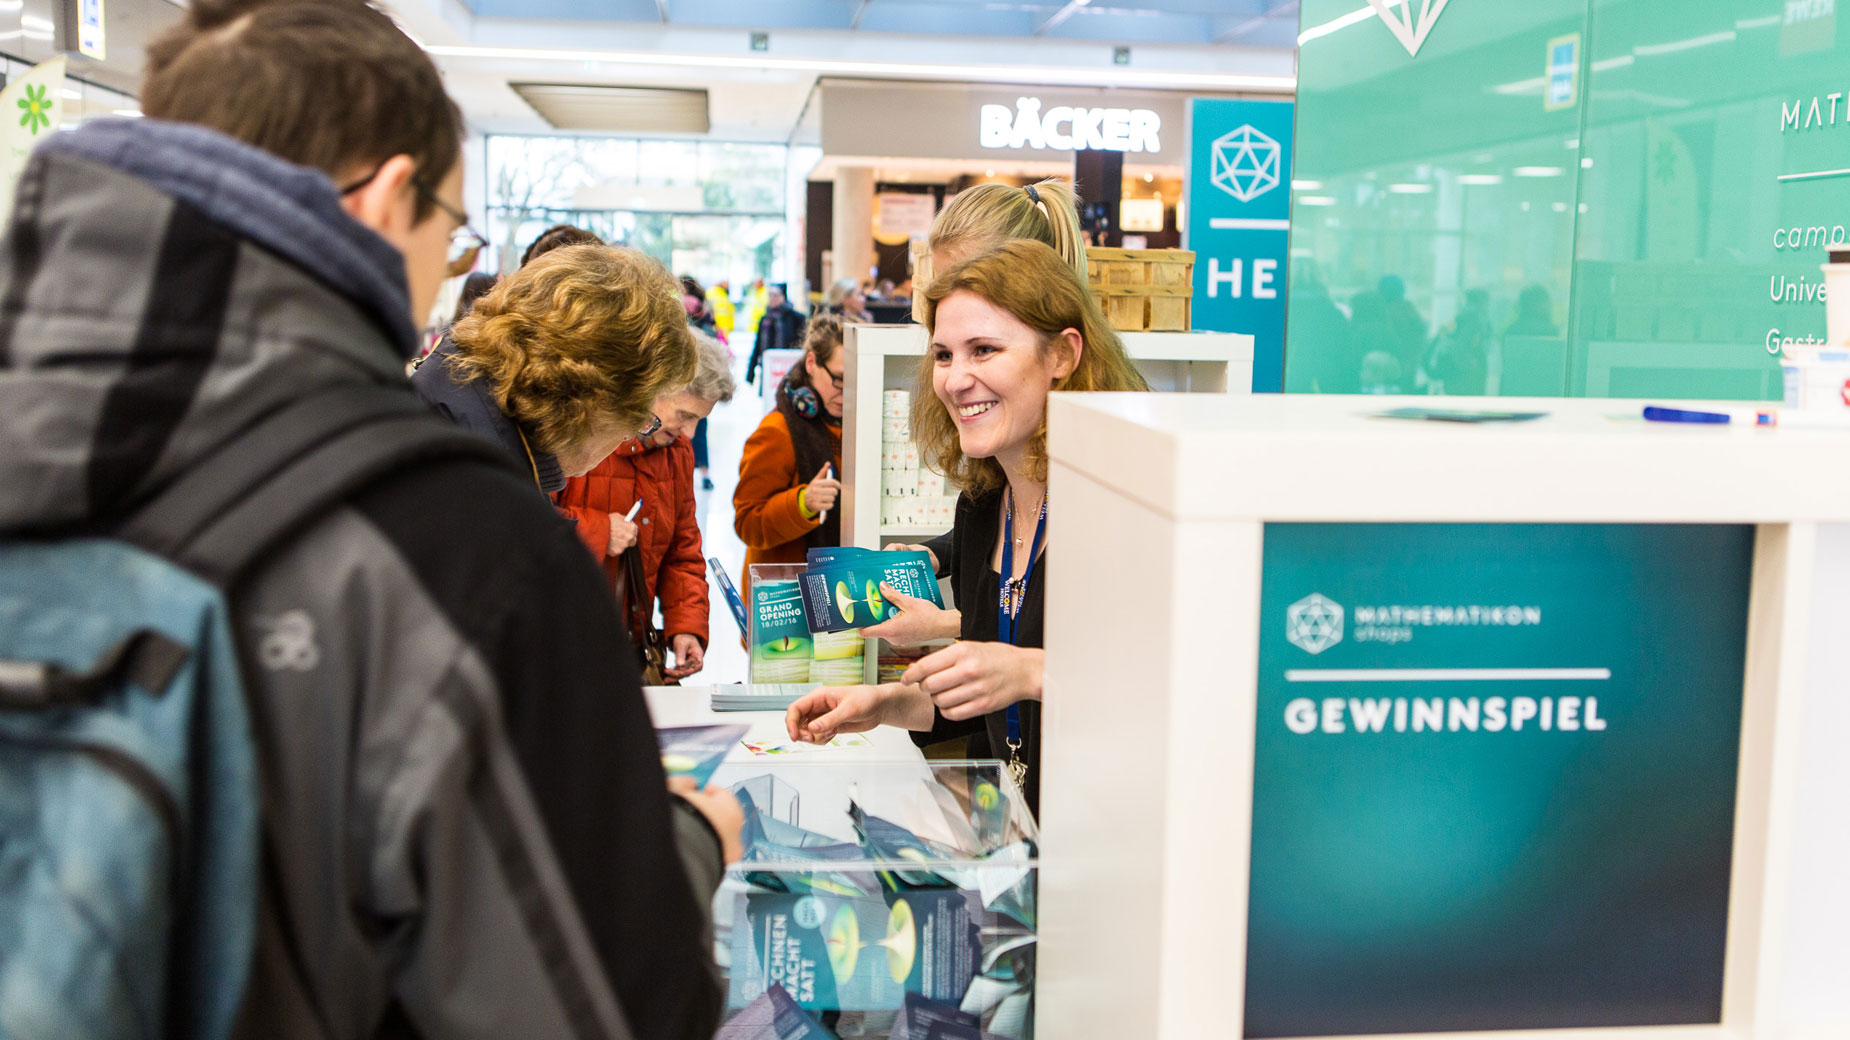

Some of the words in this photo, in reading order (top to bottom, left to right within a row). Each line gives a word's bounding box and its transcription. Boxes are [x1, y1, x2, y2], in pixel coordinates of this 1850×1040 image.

[980, 97, 1161, 152] BÄCKER
[1773, 225, 1850, 248] camp
[1208, 259, 1277, 299] HE
[759, 602, 792, 614] GRAND
[760, 608, 802, 621] OPENING
[1354, 605, 1542, 626] MATHEMATIKON
[761, 618, 797, 628] 18/02/16
[1283, 696, 1608, 735] GEWINNSPIEL
[800, 959, 816, 1003] SATT
